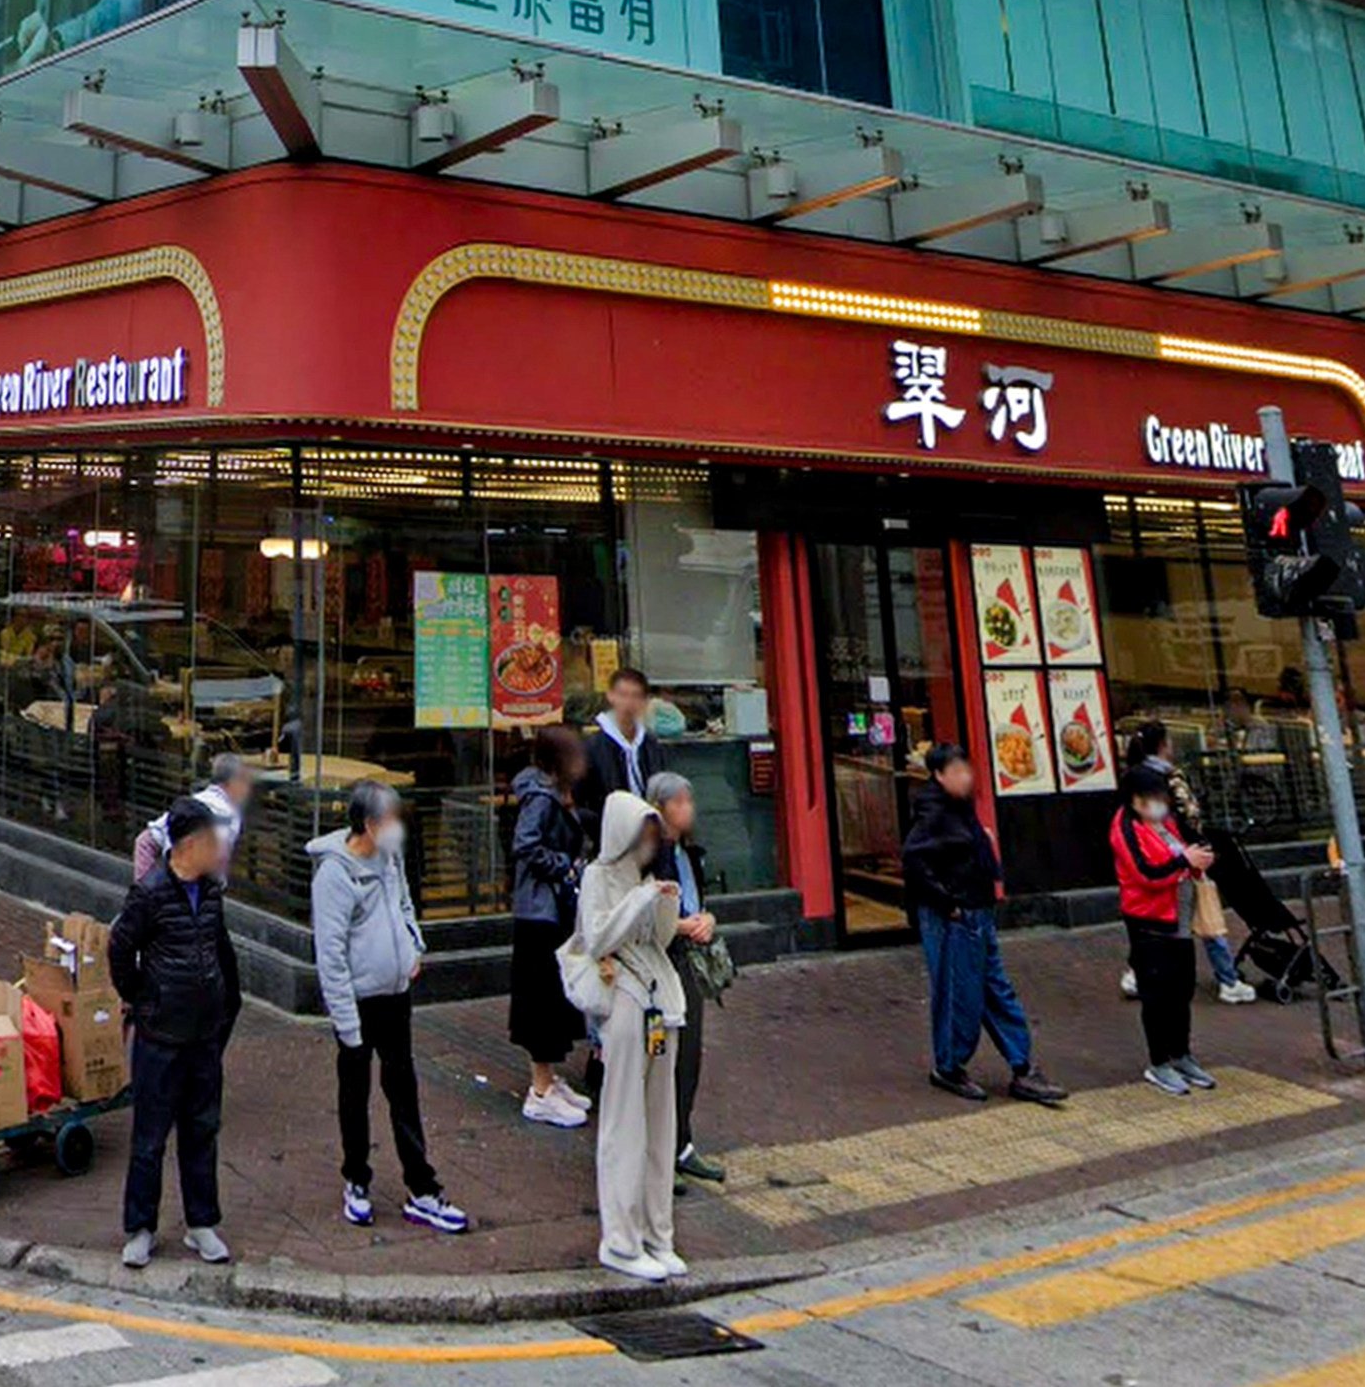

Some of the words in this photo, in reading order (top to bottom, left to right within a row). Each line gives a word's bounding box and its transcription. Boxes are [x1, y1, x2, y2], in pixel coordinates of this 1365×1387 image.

[21, 358, 73, 412] River
[75, 346, 188, 408] Restaurant
[883, 339, 1055, 454] 翠河
[1144, 414, 1210, 469] Green
[1209, 420, 1267, 474] River
